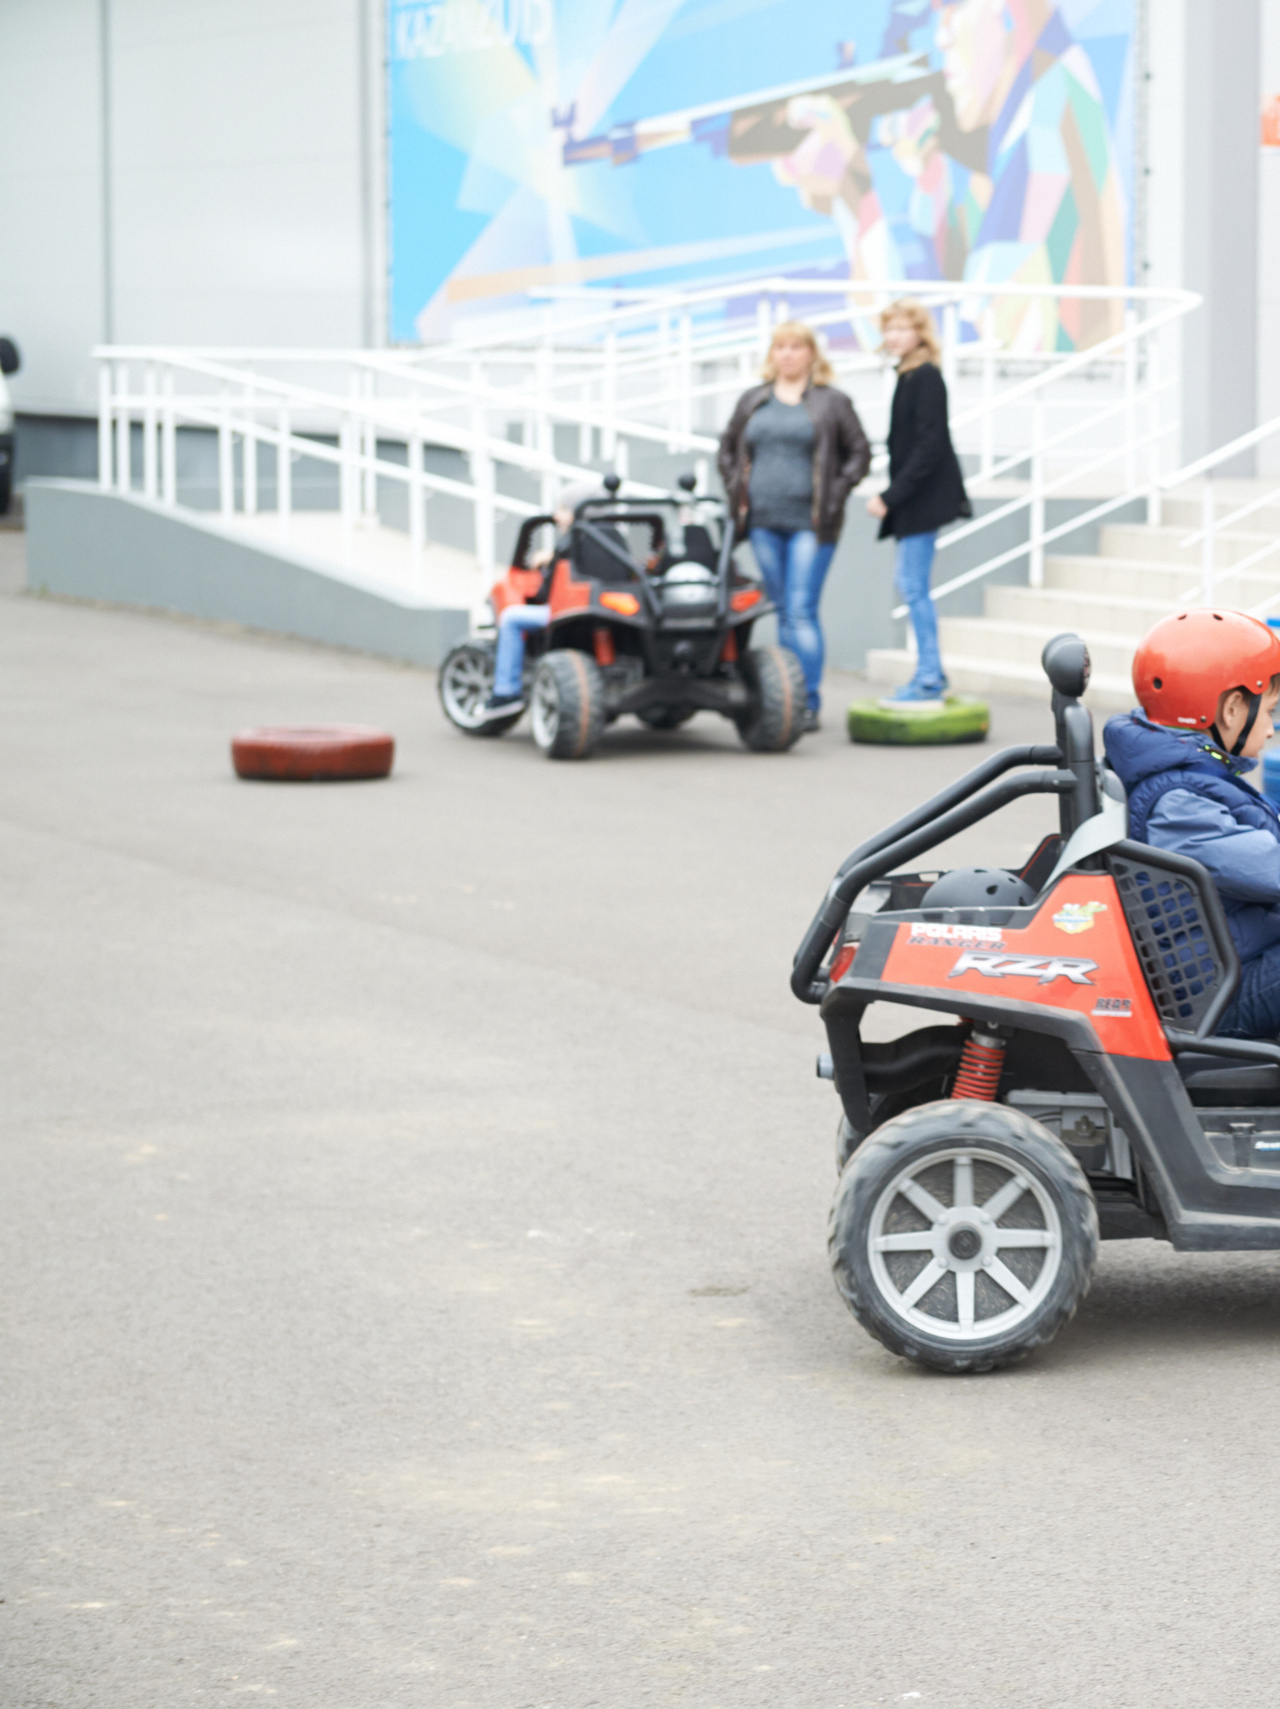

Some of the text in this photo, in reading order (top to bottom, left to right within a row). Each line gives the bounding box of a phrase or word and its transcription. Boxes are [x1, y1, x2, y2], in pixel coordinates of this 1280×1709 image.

[911, 922, 1002, 941] POLARIS
[908, 936, 1006, 950] RANGER
[946, 950, 1099, 985] RZR
